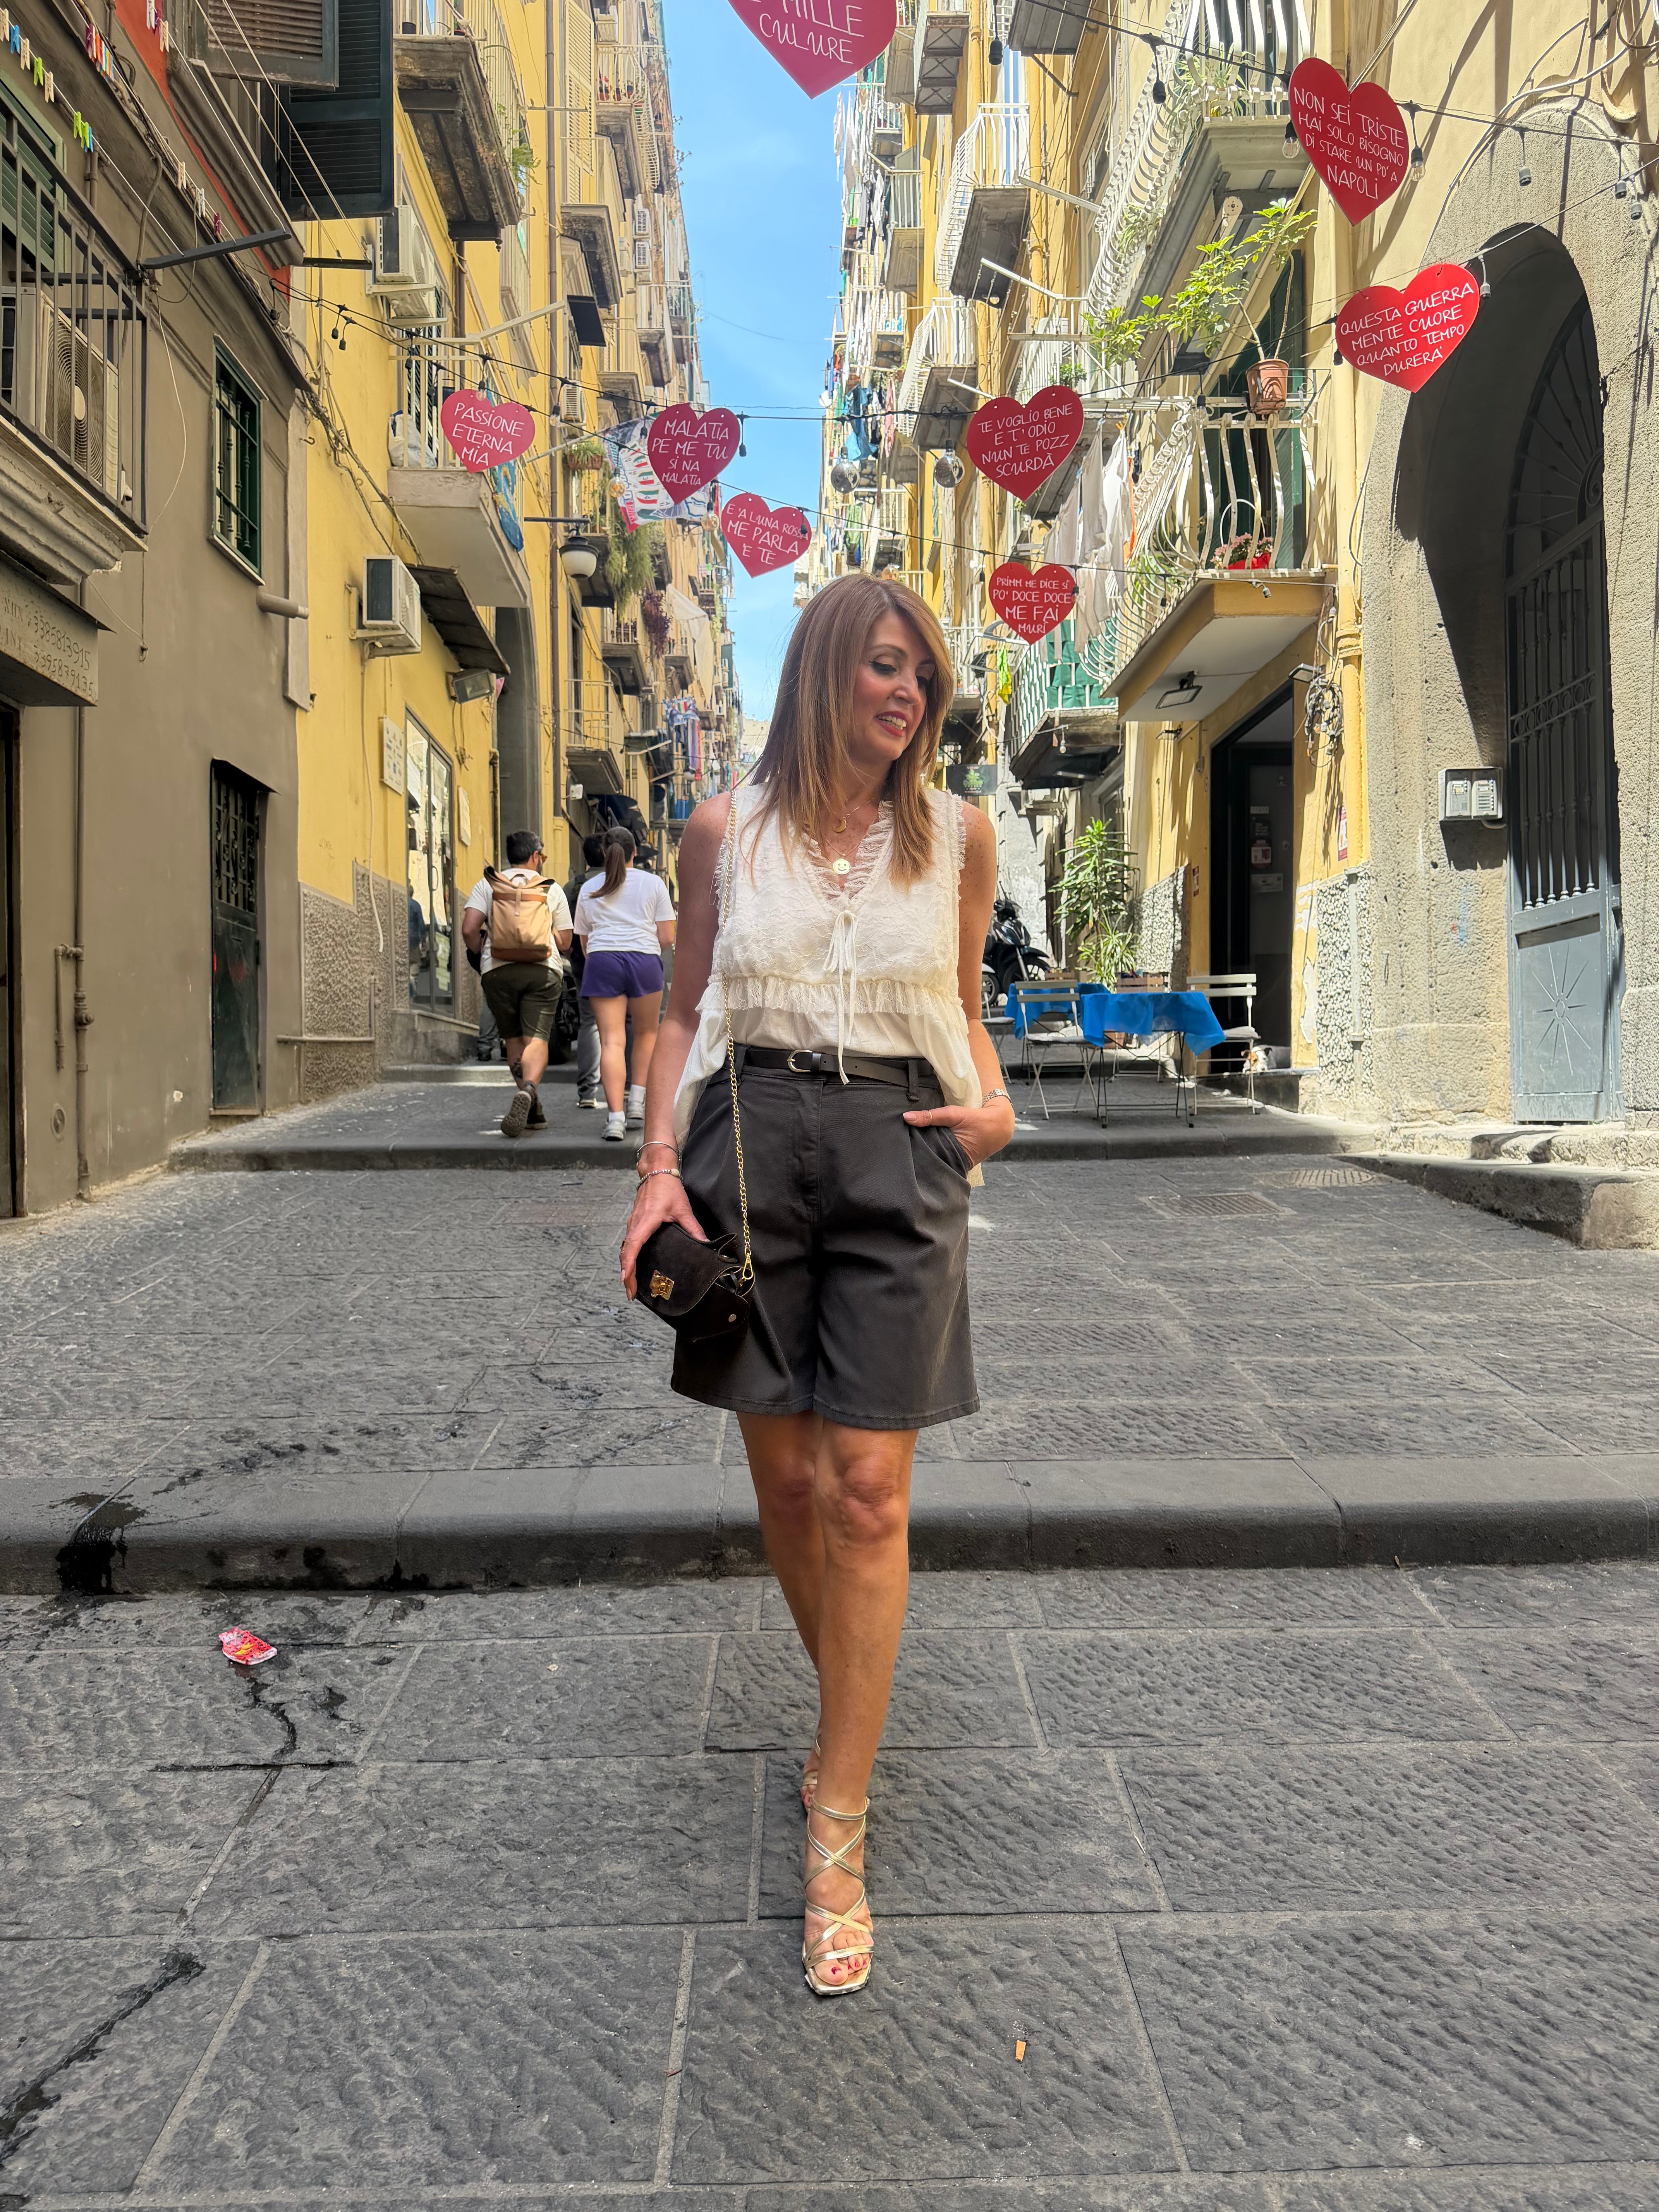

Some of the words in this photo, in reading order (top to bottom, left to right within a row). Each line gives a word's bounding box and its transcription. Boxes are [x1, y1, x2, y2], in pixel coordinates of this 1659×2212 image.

[759, 13, 854, 64] CULURE
[1294, 87, 1324, 114] NON
[1331, 103, 1350, 125] SEI
[1356, 113, 1405, 148] TRISTE
[1299, 112, 1321, 132] HAI
[1327, 124, 1354, 145] SOLO
[1359, 137, 1403, 166] BISOGNO
[1319, 140, 1352, 163] STARE
[1356, 156, 1372, 172] UN
[1391, 172, 1398, 183] A
[1327, 165, 1378, 200] NAPOLI
[1340, 306, 1401, 335] QUESTA
[1405, 282, 1474, 316] GUERRA
[1352, 323, 1405, 351] MENTE
[1409, 304, 1463, 332] CUORE
[1357, 338, 1417, 366] QUANTO
[1421, 324, 1464, 345] TEMPO
[454, 402, 525, 437] PASSIONE
[664, 419, 729, 440] MALATIA
[977, 420, 993, 433] TE
[997, 409, 1039, 429] VOGLIO
[1044, 403, 1073, 419] BENE
[452, 423, 512, 455] ETERNA
[651, 438, 672, 453] PE
[675, 441, 699, 456] ME
[703, 443, 728, 460] TU
[982, 446, 1013, 465] NUN
[1016, 443, 1030, 455] TE
[1036, 434, 1070, 452] POZZ
[994, 431, 1004, 446] E
[461, 446, 489, 466] MIA
[682, 460, 700, 472] NA
[662, 472, 701, 485] MALATIA
[727, 504, 735, 515] E
[750, 512, 779, 530] LUNA
[782, 523, 809, 541] ROSSA
[727, 520, 750, 538] ME
[752, 527, 799, 555] PARLA
[757, 547, 776, 565] TE
[993, 589, 1008, 600] PO'
[1012, 590, 1040, 602] DOCE
[1044, 592, 1072, 604] DOCE
[996, 576, 1022, 587] PRIMM
[1025, 580, 1037, 588] ME
[1040, 578, 1059, 589] DICE
[1005, 605, 1027, 620] ME
[1033, 604, 1060, 622] FAI
